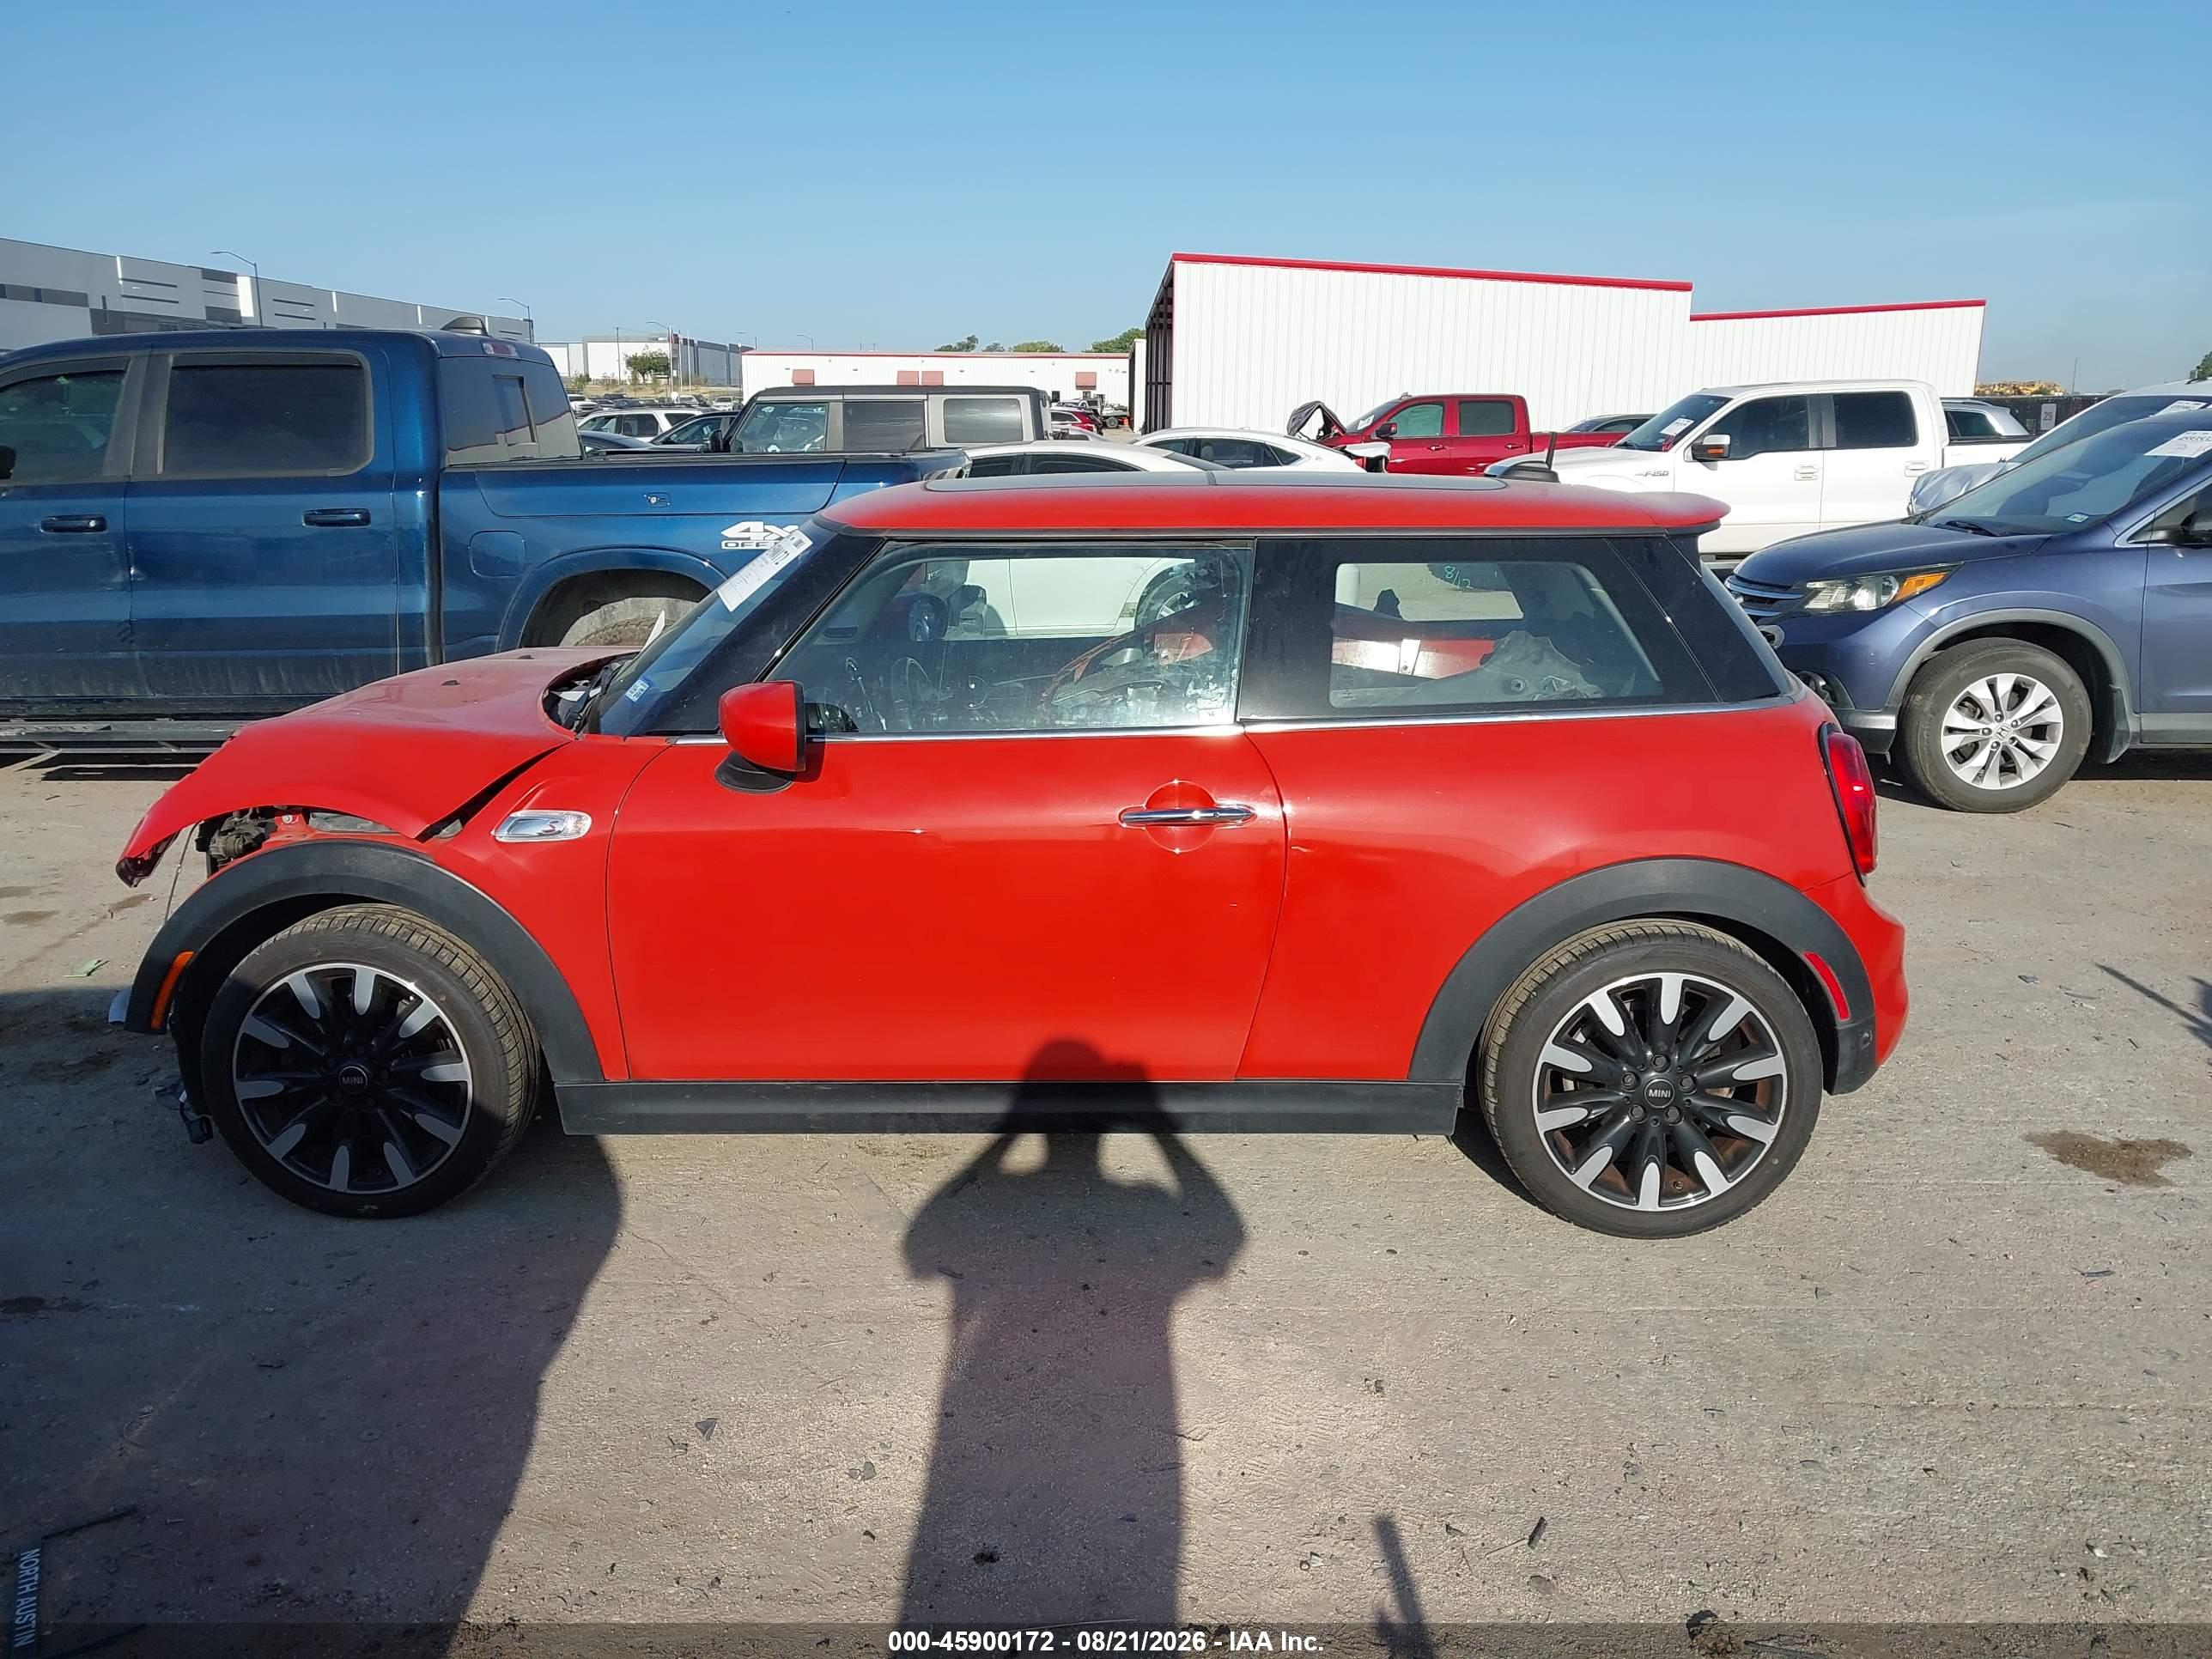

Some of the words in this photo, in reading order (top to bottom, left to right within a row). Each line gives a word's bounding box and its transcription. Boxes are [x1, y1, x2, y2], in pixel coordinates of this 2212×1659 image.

[720, 521, 799, 540] 4X
[342, 1076, 364, 1085] MINI
[1649, 1089, 1671, 1097] MINI
[17, 1548, 40, 1595] NORTH
[14, 1597, 37, 1647] AUSTIN
